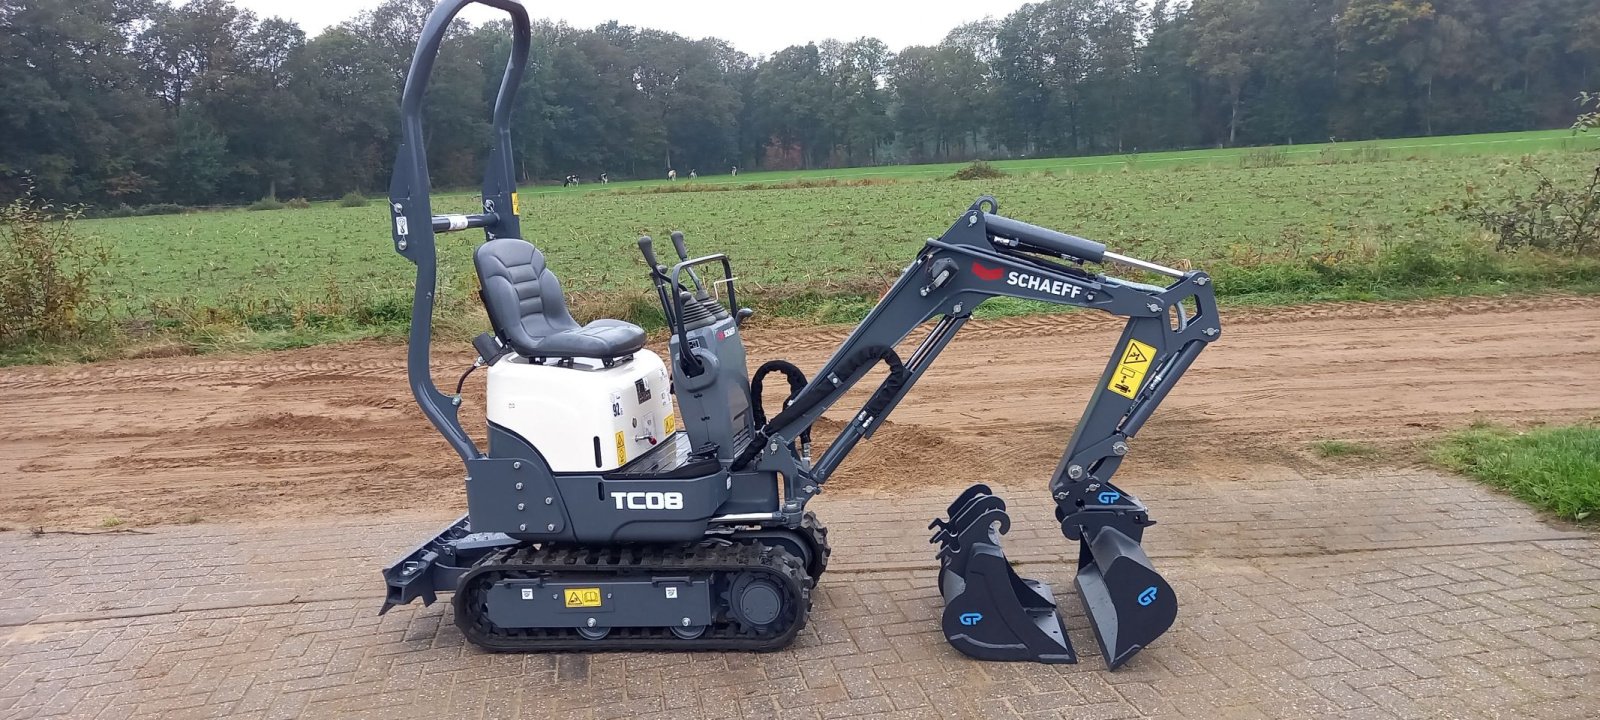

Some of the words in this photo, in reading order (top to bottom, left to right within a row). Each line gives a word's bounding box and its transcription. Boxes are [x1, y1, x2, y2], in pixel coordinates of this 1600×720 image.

[1007, 271, 1083, 299] SCHAEFF
[611, 491, 684, 509] TC08
[1098, 491, 1120, 504] GP
[1138, 586, 1158, 606] GP
[959, 612, 983, 625] GP
